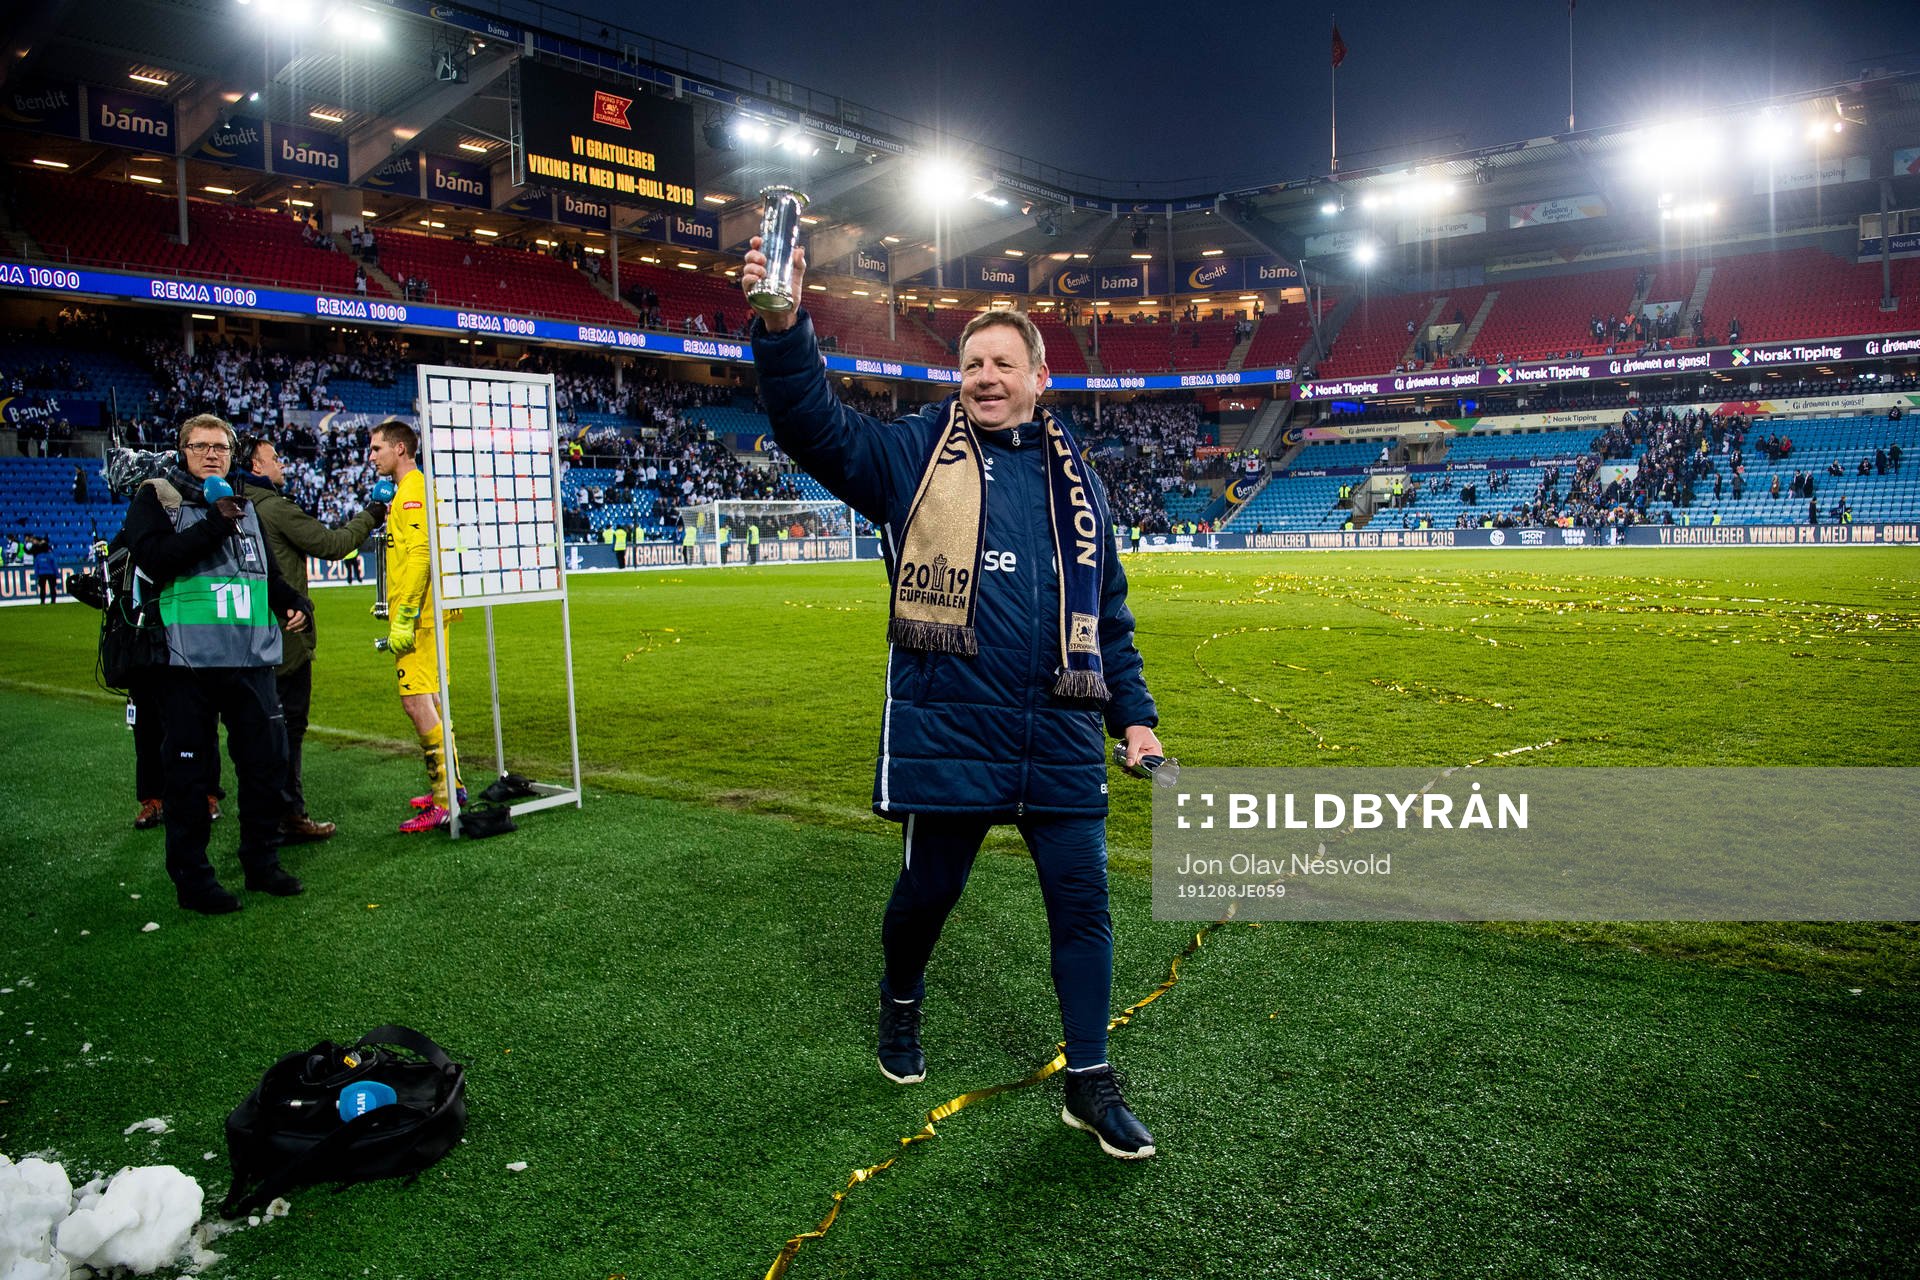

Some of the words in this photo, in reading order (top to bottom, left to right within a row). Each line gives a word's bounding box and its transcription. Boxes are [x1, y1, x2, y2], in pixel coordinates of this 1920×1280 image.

[487, 23, 510, 38] bama
[101, 104, 168, 137] bama
[214, 127, 259, 147] Bendit
[282, 139, 339, 169] bama
[571, 135, 584, 156] VI
[586, 138, 656, 172] GRATULERER
[435, 168, 484, 196] bama
[527, 153, 571, 181] VIKING
[572, 163, 588, 184] FK
[589, 167, 615, 190] MED
[616, 172, 665, 200] NM-GULL
[666, 184, 695, 207] 2019
[565, 196, 607, 218] bama
[677, 217, 713, 239] bama
[1892, 239, 1916, 249] Norsk
[858, 253, 886, 273] bama
[0, 265, 24, 284] MA
[29, 267, 80, 289] 1000
[982, 267, 1016, 284] bama
[1066, 273, 1092, 288] Bendit
[1101, 275, 1138, 290] bama
[1198, 264, 1228, 283] Bendit
[1259, 265, 1298, 281] bama
[151, 280, 210, 302] REMA
[213, 286, 257, 307] 1000
[316, 297, 367, 319] REMA
[369, 302, 407, 322] 1000
[457, 312, 501, 332] REMA
[503, 317, 536, 335] 1000
[578, 326, 617, 345] REMA
[618, 330, 646, 347] 1000
[683, 339, 717, 356] REMA
[718, 343, 743, 358] 1000
[1754, 348, 1792, 363] Norsk
[1793, 345, 1842, 361] Tipping
[1866, 340, 1880, 355] Gi
[1882, 338, 1920, 354] drømme
[855, 359, 882, 374] REMA
[882, 361, 903, 376] 1000
[1515, 367, 1548, 381] Norsk
[1548, 365, 1590, 380] Tipping
[1609, 360, 1621, 375] Gi
[1622, 357, 1662, 373] drømmen
[1664, 358, 1675, 370] en
[1676, 352, 1711, 371] sjanse!
[927, 368, 951, 382] REMA
[1087, 378, 1118, 388] REMA
[1120, 377, 1145, 388] 1000
[1181, 375, 1214, 386] REMA
[1215, 373, 1241, 384] 1000
[1440, 376, 1450, 387] en
[1451, 371, 1480, 387] sjanse!
[1315, 383, 1342, 396] Norsk
[1342, 382, 1378, 396] Tipping
[1572, 414, 1598, 424] Tipping
[762, 439, 778, 450] Ben
[1090, 445, 1113, 460] Bendit
[1245, 535, 1254, 548] VI
[1255, 534, 1306, 548] GRATULERER
[1309, 533, 1342, 548] VIKING
[1343, 533, 1357, 547] FK
[1359, 532, 1378, 547] MED
[1431, 531, 1455, 546] 2019
[1561, 529, 1586, 538] REMA
[1564, 537, 1584, 545] 1000
[1659, 528, 1671, 544] VI
[1673, 527, 1744, 544] GRATULERER
[1749, 526, 1796, 543] VIKING
[1798, 526, 1815, 543] FK
[1820, 525, 1847, 542] MED
[1851, 525, 1919, 542] NM-GULL
[759, 542, 780, 561] MED
[828, 539, 850, 558] 2019
[327, 553, 365, 580] 209
[983, 550, 1017, 573] se
[901, 562, 930, 589] 20
[948, 568, 969, 594] 19
[210, 583, 251, 619] TV
[899, 588, 967, 609] CUPFINALEN
[180, 751, 194, 759] nrk
